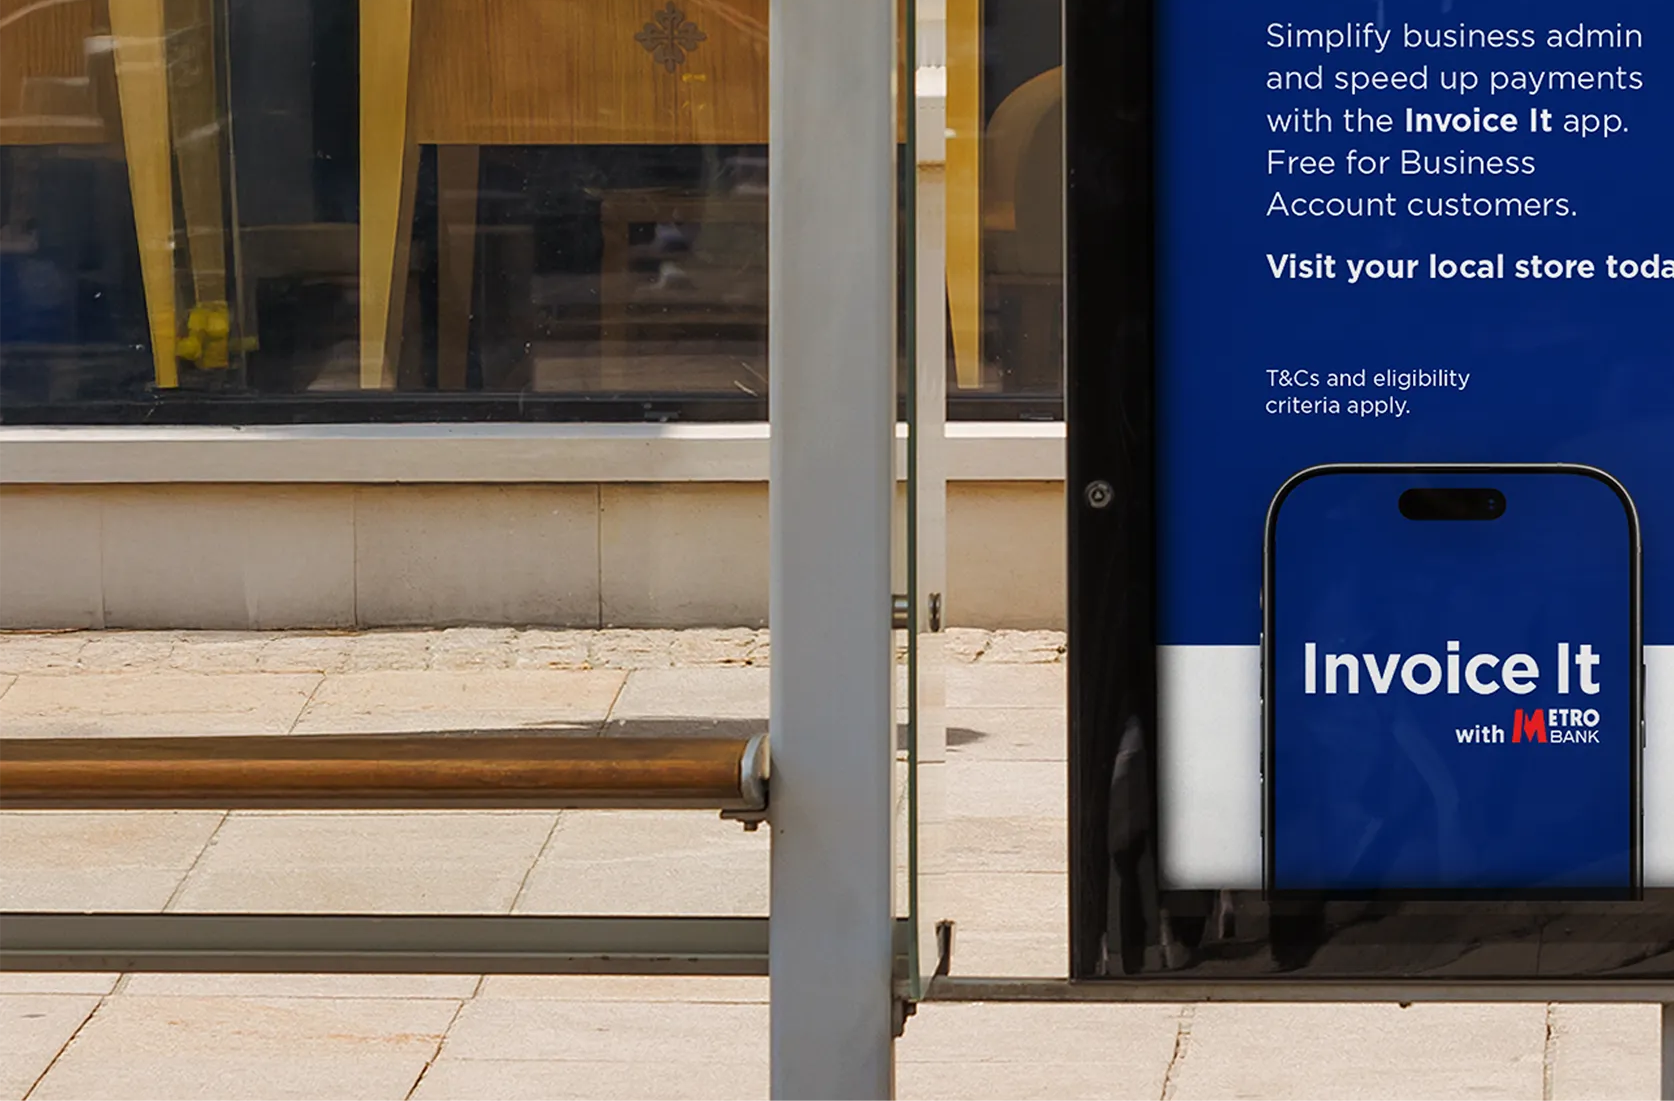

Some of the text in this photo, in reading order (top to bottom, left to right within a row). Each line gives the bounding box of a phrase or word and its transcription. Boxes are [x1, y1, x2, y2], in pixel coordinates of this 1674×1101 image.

[1268, 23, 1641, 53] Simplify business admin
[1267, 65, 1642, 95] and speed up payments
[1267, 107, 1627, 137] with the Invoice It app.
[1269, 150, 1534, 174] Free for Business
[1267, 192, 1576, 216] Account customers.
[1266, 254, 1335, 278] Visit
[1347, 260, 1418, 283] your
[1430, 254, 1503, 278] local
[1515, 256, 1594, 278] store
[1267, 369, 1469, 390] T&Cs and eligibility
[1266, 396, 1409, 417] criteria apply.
[1305, 641, 1599, 694] Invoice It
[1456, 708, 1600, 744] with METRO
[1549, 729, 1600, 744] BANK
